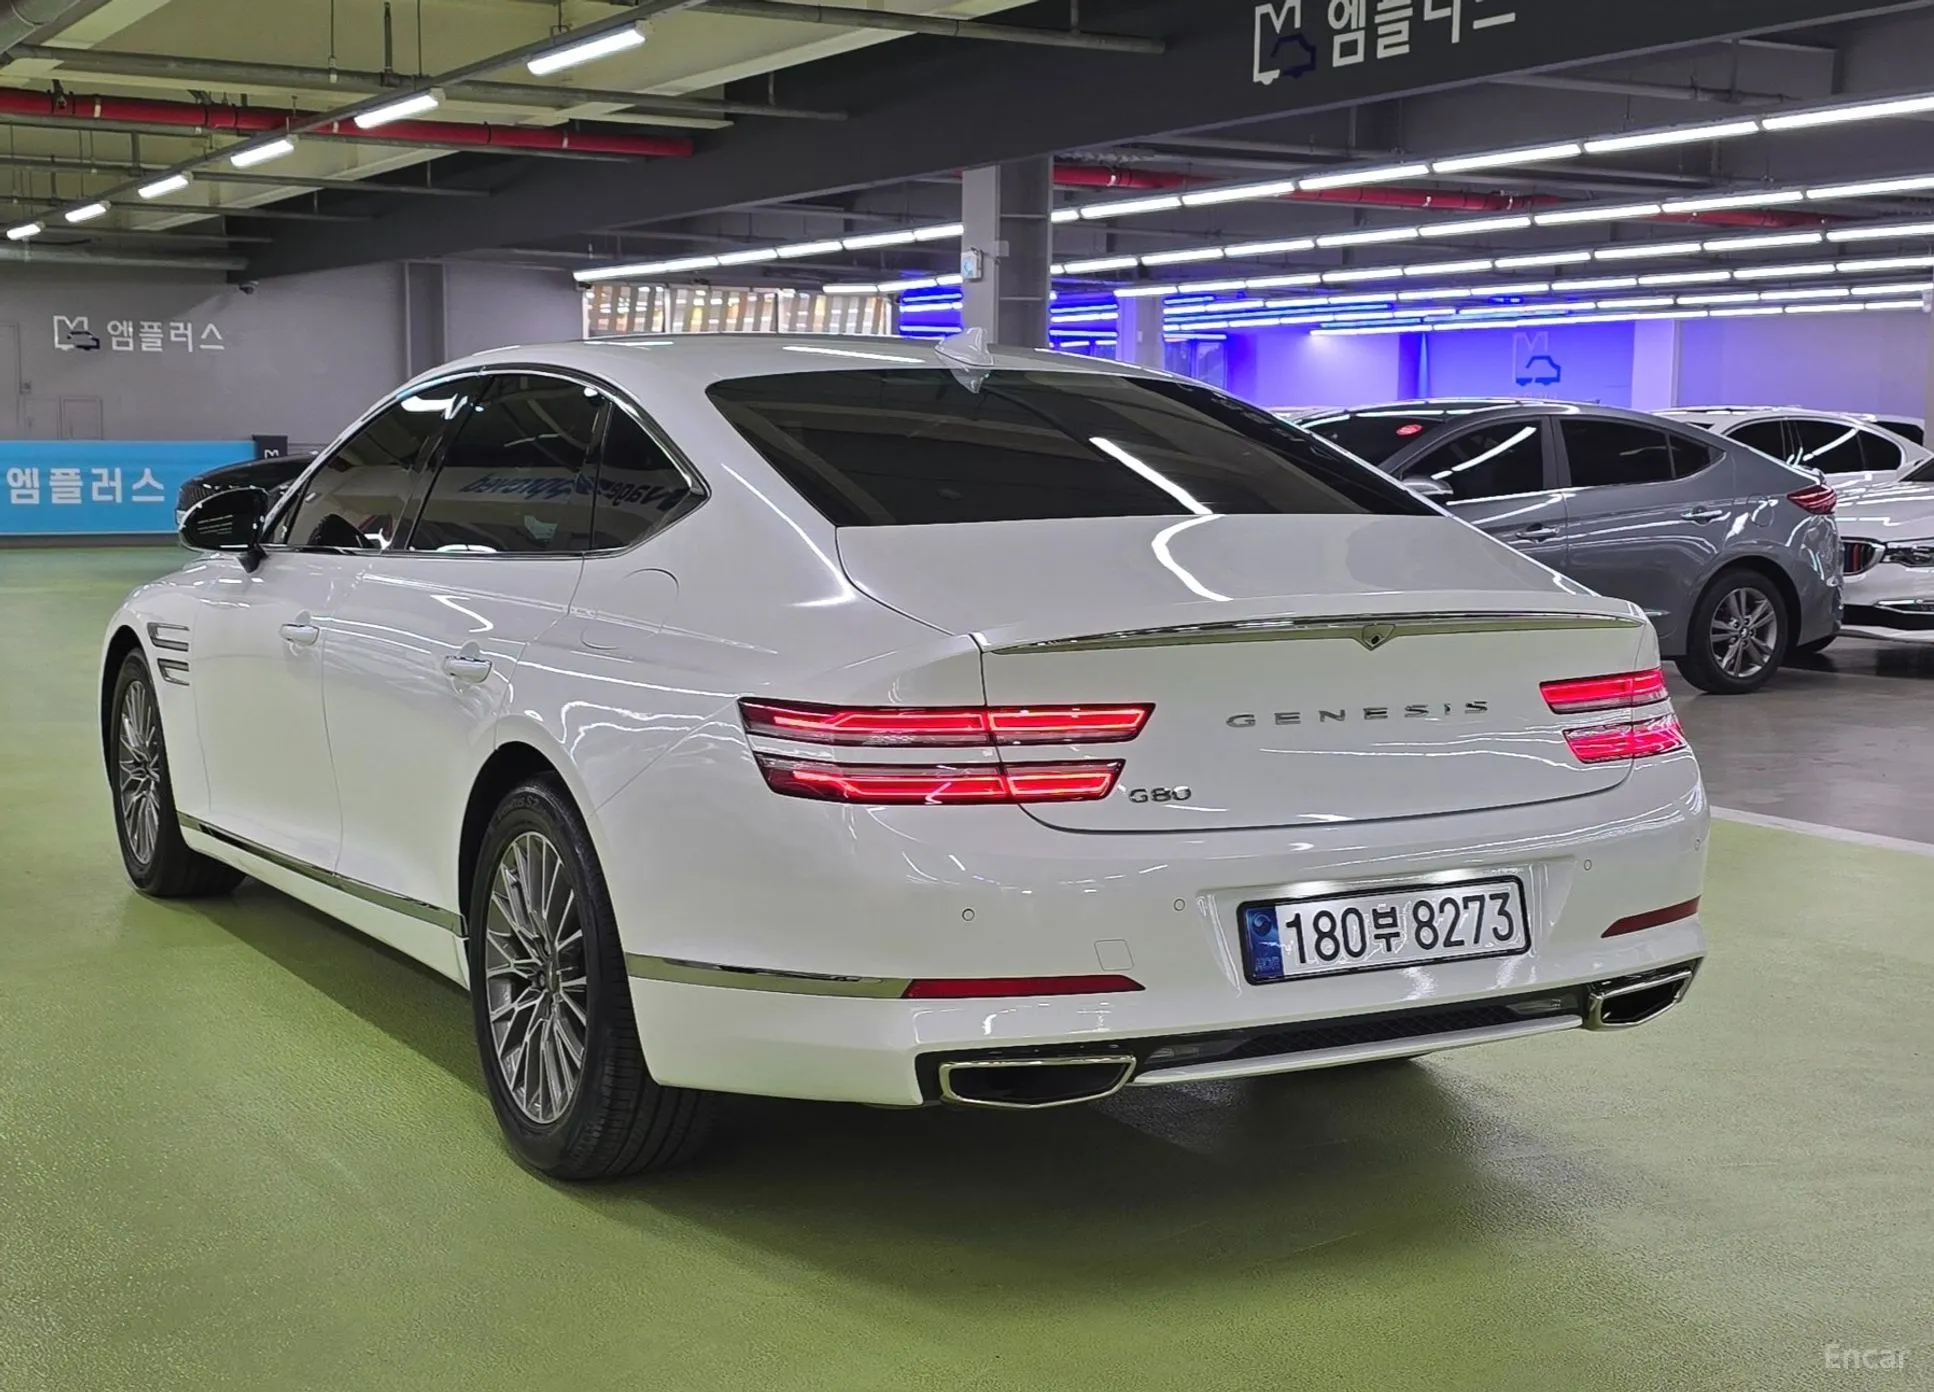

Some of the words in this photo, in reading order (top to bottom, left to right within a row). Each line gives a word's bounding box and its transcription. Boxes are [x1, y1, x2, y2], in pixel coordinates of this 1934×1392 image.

[106, 320, 225, 352] 엠플러스
[6, 467, 165, 504] 엠플러스
[1226, 701, 1488, 728] GENESIS
[1129, 785, 1192, 803] G80
